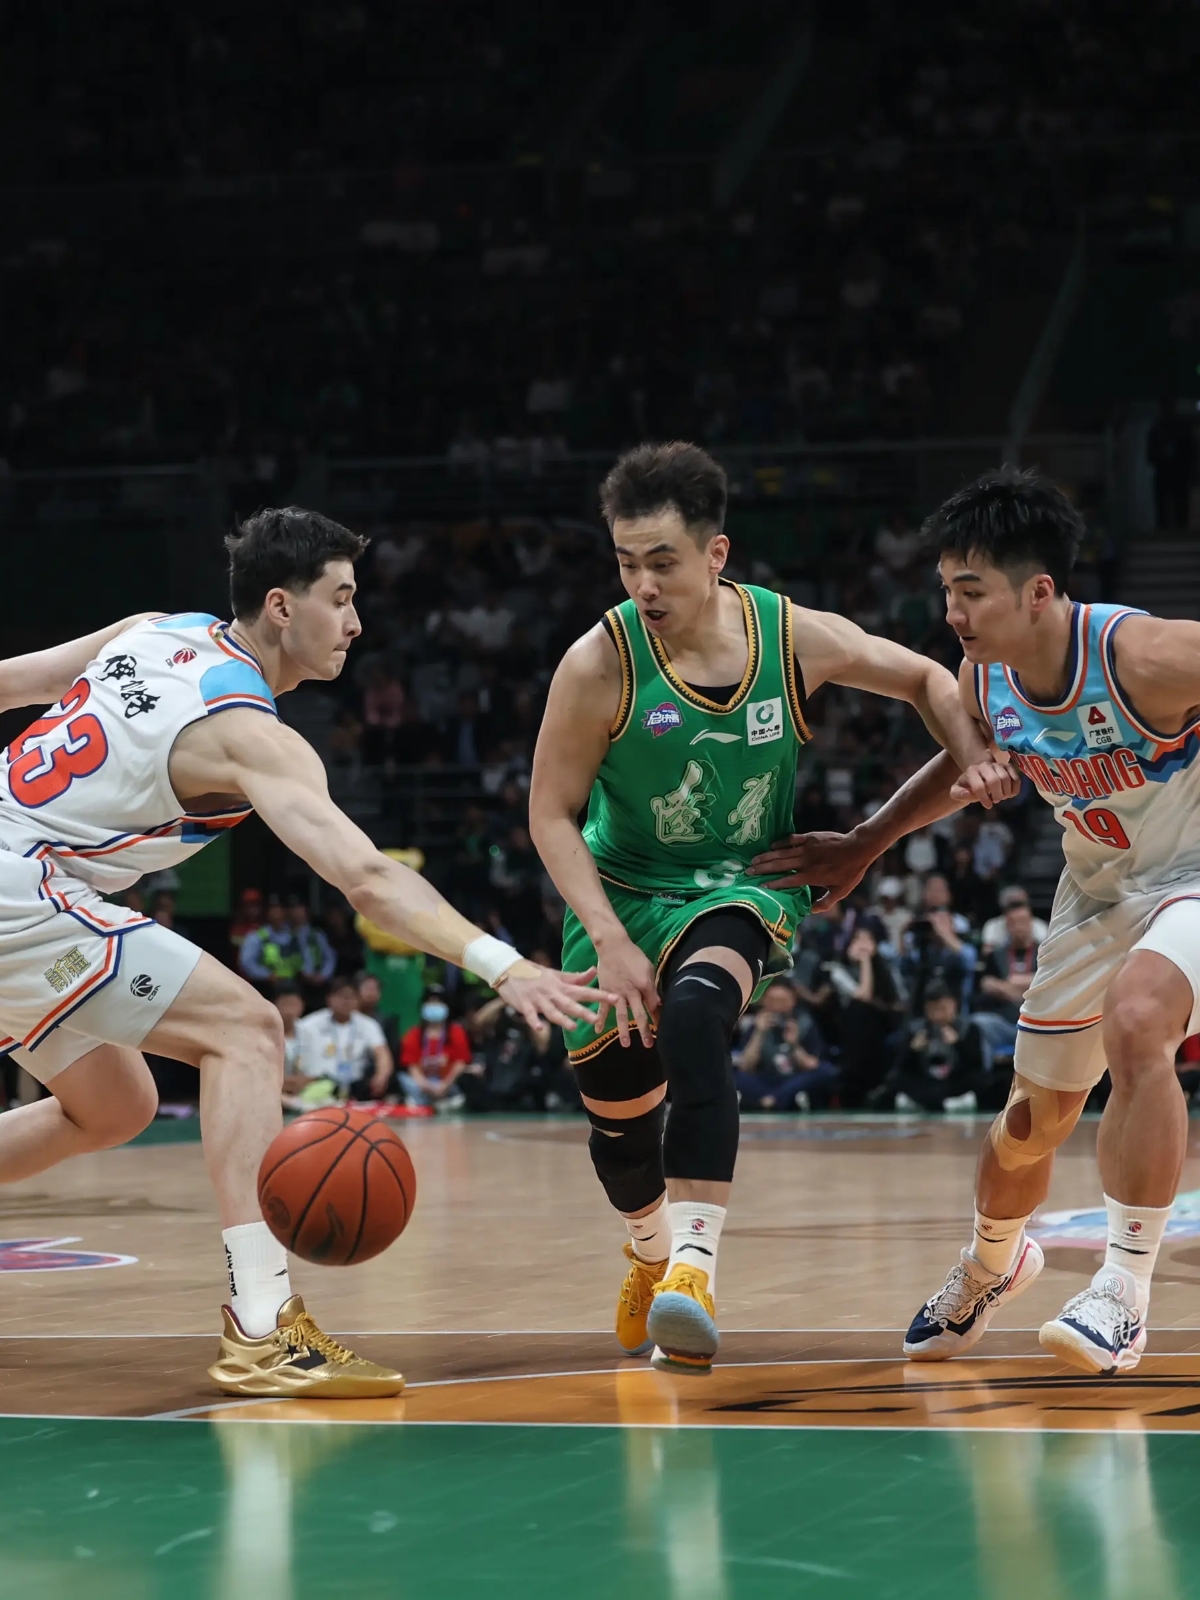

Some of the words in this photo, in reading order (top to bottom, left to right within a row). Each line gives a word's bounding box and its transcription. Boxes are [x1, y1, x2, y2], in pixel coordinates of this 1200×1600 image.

[6, 677, 109, 809] 23
[1096, 736, 1112, 745] CGB
[1062, 807, 1131, 850] 19
[147, 984, 161, 1001] CBA
